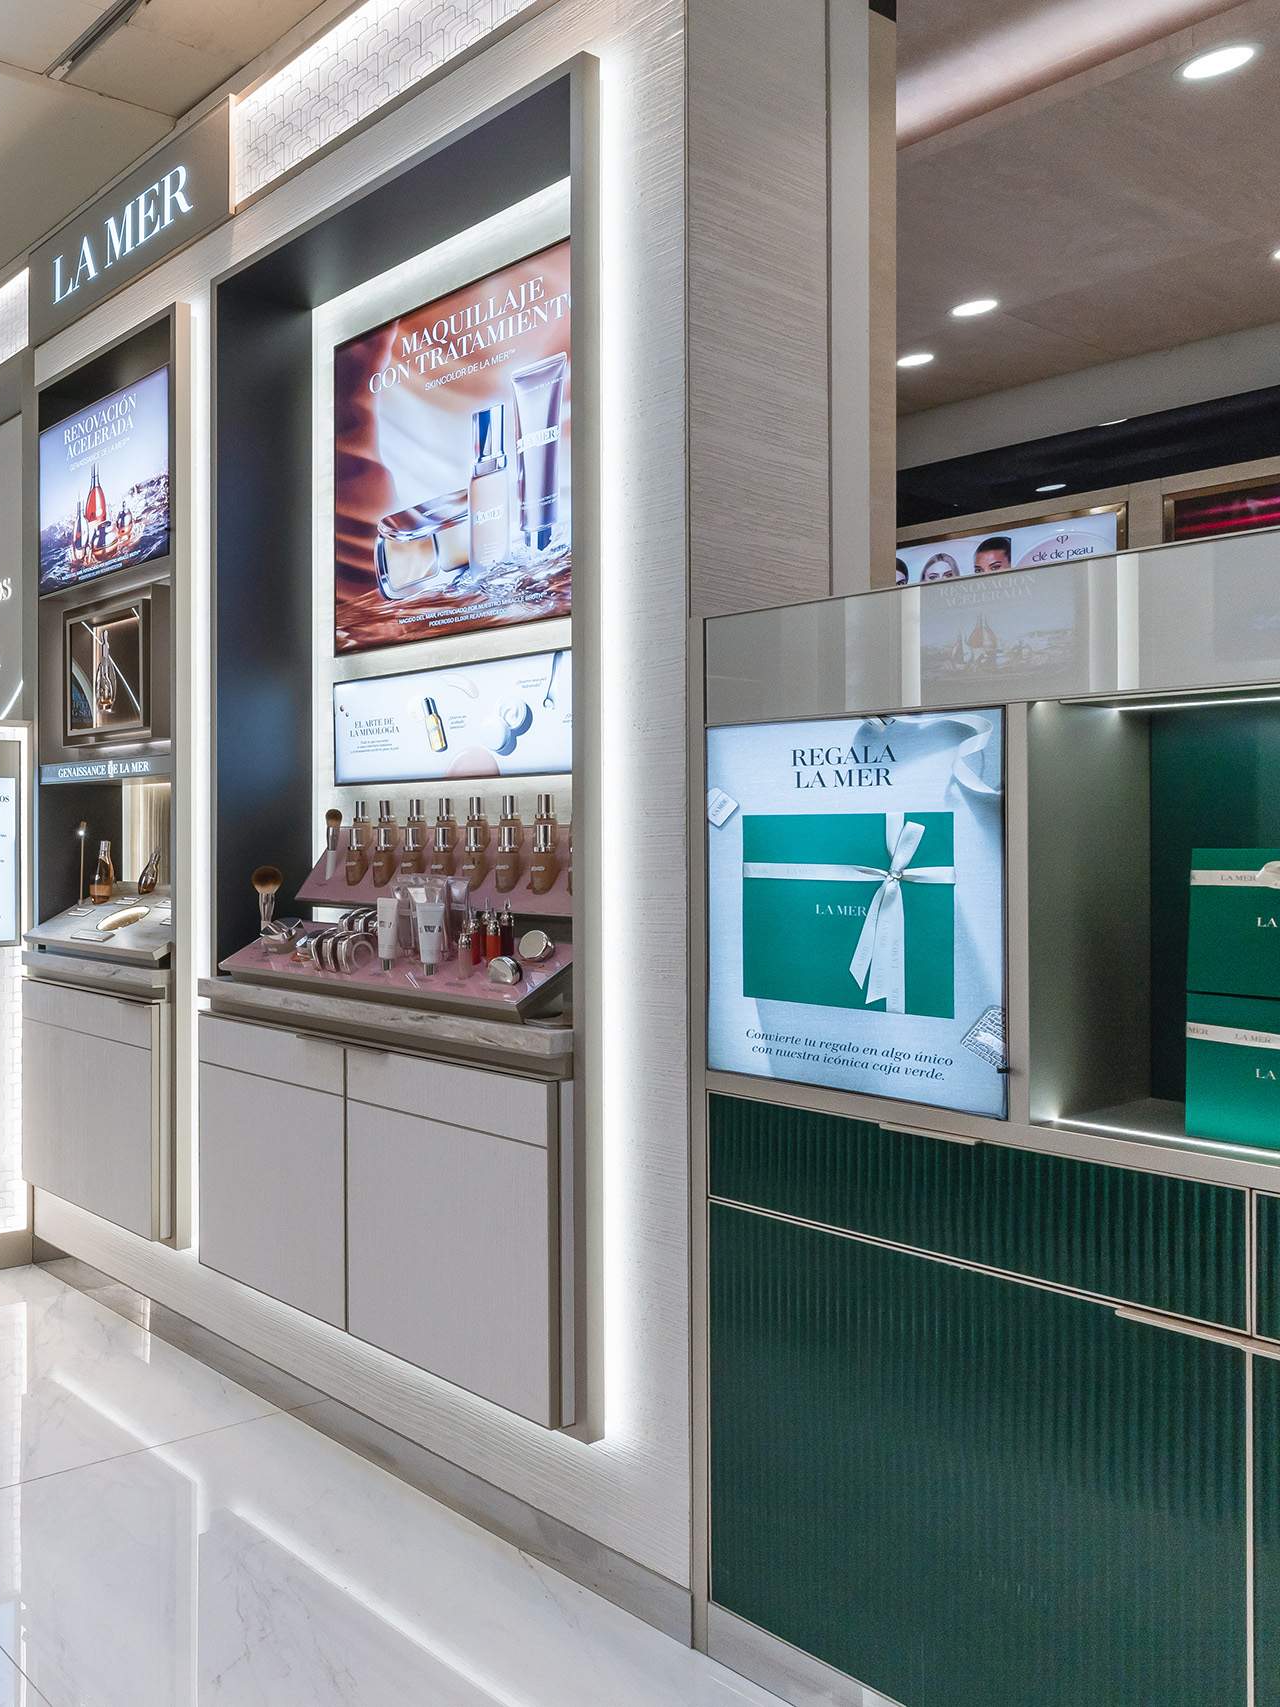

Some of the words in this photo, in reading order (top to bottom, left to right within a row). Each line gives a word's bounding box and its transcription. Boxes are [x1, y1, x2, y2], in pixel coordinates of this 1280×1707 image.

[52, 235, 99, 305] LA
[104, 165, 194, 269] MER
[400, 276, 545, 357] MAQUILLAJE
[368, 359, 411, 394] CON
[415, 292, 571, 375] TRATAMIENT
[424, 367, 467, 391] SKINCOLOR
[467, 362, 479, 375] DE
[480, 359, 490, 369] LA
[63, 393, 137, 446] RENOVACIÓN
[66, 414, 134, 461] ACELERADA
[1032, 551, 1048, 562] clé
[1050, 549, 1064, 559] de
[1066, 546, 1094, 559] peau
[350, 729, 359, 738] LA
[354, 720, 363, 729] EL
[365, 718, 383, 728] ARTE
[384, 717, 395, 726] DE
[791, 744, 898, 767] REGALA
[58, 765, 107, 778] GENAISSANCE
[107, 763, 118, 775] DE
[119, 762, 130, 774] LA
[131, 760, 150, 773] MER
[794, 770, 827, 788] LA
[833, 767, 893, 788] MER
[816, 904, 833, 915] LA
[837, 905, 867, 916] MER
[1257, 916, 1278, 928] LA
[1188, 1026, 1209, 1035] MER
[1235, 1033, 1248, 1041] LA
[1249, 1035, 1272, 1044] MER
[745, 1028, 802, 1046] Convierte
[804, 1038, 817, 1048] tu
[819, 1040, 860, 1054] regalo
[862, 1046, 878, 1056] en
[881, 1047, 911, 1062] algo
[914, 1050, 954, 1067] único
[751, 1045, 772, 1055] con
[775, 1046, 820, 1062] nuestra
[823, 1053, 869, 1069] icónica
[872, 1061, 901, 1075] caja
[904, 1066, 945, 1081] verde.
[1256, 1068, 1276, 1080] LA
